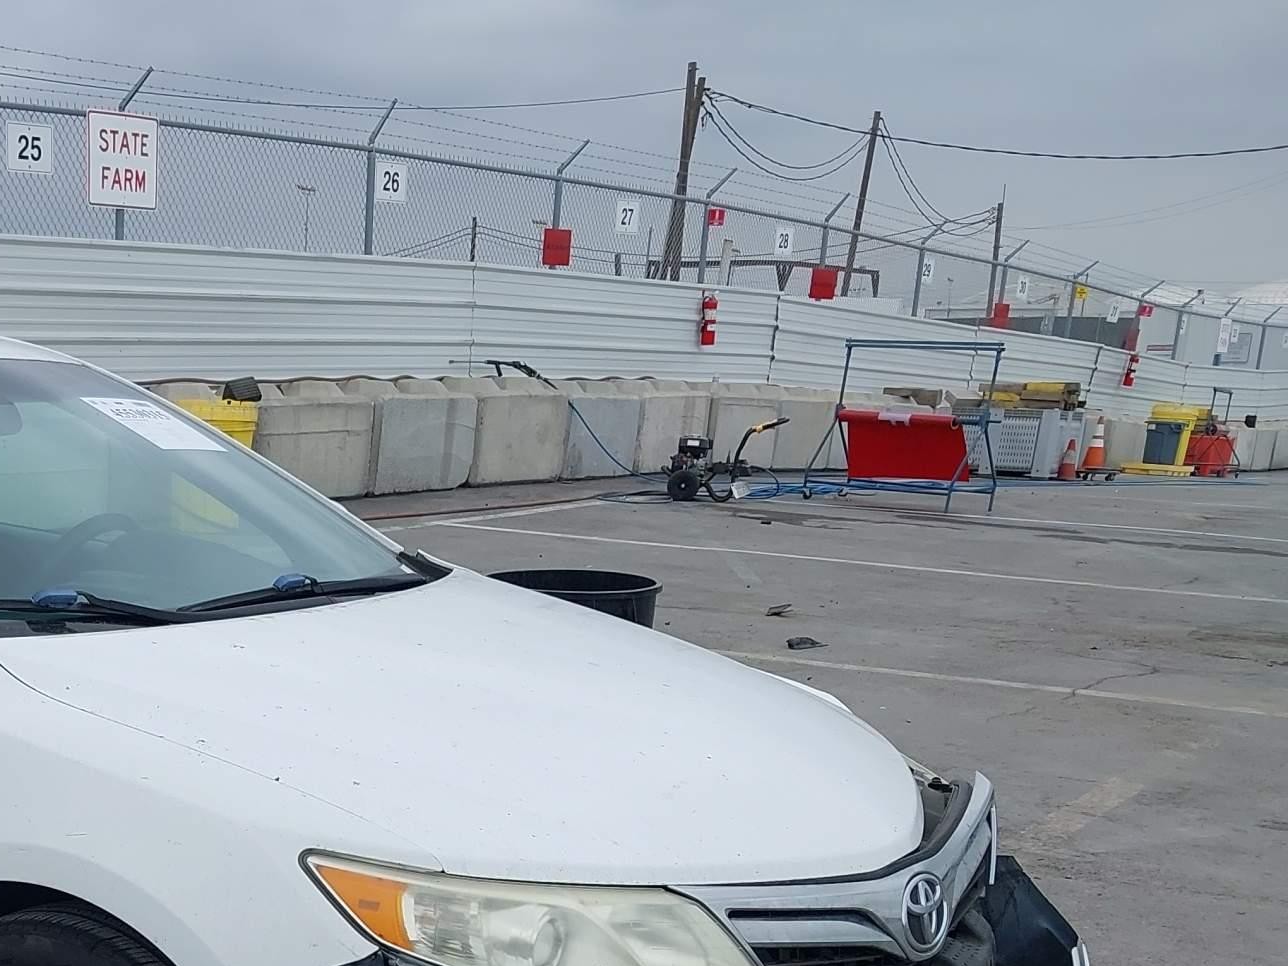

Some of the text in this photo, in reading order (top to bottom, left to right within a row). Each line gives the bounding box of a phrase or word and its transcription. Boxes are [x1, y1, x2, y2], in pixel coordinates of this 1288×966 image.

[17, 134, 42, 162] 25
[98, 128, 150, 158] STATE
[100, 165, 147, 194] FARM
[382, 170, 400, 193] 26
[620, 207, 634, 226] 27
[778, 232, 790, 249] 28
[922, 263, 932, 278] 29
